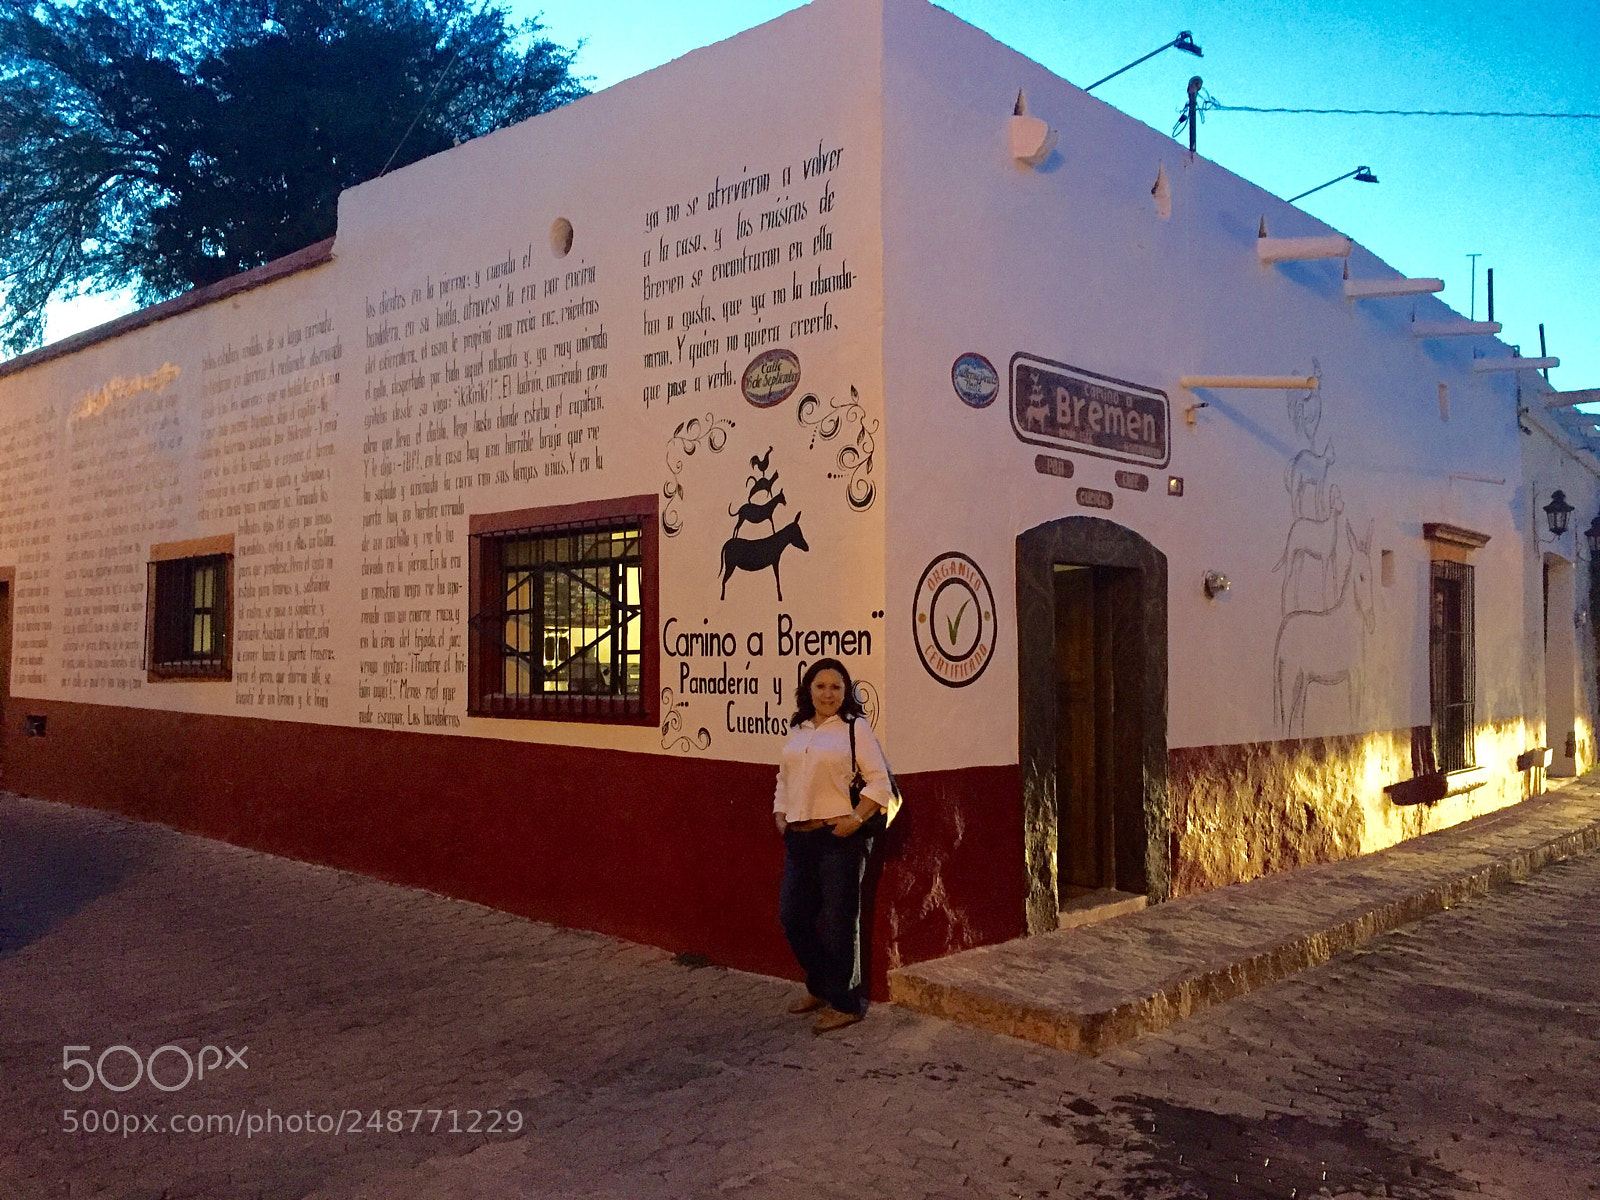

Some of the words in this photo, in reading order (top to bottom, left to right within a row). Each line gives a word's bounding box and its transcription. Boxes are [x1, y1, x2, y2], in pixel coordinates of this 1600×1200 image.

[644, 210, 659, 234] ya
[667, 204, 679, 223] no
[686, 197, 698, 216] se
[708, 166, 770, 210] atrevieron
[782, 166, 791, 187] a
[803, 138, 844, 180] volver
[643, 248, 651, 267] a
[660, 234, 669, 262] la
[714, 227, 722, 252] y
[737, 209, 753, 240] los
[820, 179, 835, 214] de
[412, 288, 421, 305] en
[427, 274, 434, 299] la
[475, 271, 480, 289] y
[522, 242, 532, 270] el
[643, 275, 684, 301] Bremen
[691, 269, 703, 288] se
[712, 245, 780, 282] encontraron
[789, 242, 802, 262] en
[813, 224, 833, 256] ella
[419, 316, 429, 334] su
[506, 283, 514, 308] la
[521, 283, 537, 304] era
[544, 277, 560, 298] por
[565, 259, 596, 290] encima
[667, 316, 674, 331] a
[722, 299, 742, 323] que
[751, 293, 766, 315] ya
[773, 288, 786, 306] no
[792, 270, 802, 302] la
[677, 333, 686, 363] Y
[689, 329, 719, 369] quien
[727, 334, 739, 352] no
[744, 317, 780, 354] quiera
[502, 374, 512, 398] El
[761, 359, 782, 374] Calle
[555, 391, 563, 418] el
[643, 385, 661, 409] que
[667, 379, 687, 405] pase
[694, 376, 701, 392] a
[1056, 386, 1156, 443] Bremen
[567, 428, 583, 450] que
[595, 445, 603, 470] la
[663, 617, 737, 657] Camino
[747, 631, 763, 656] a
[777, 613, 872, 656] Bremen
[680, 661, 759, 695] Panadería
[773, 677, 781, 705] y
[726, 700, 788, 736] Cuentos
